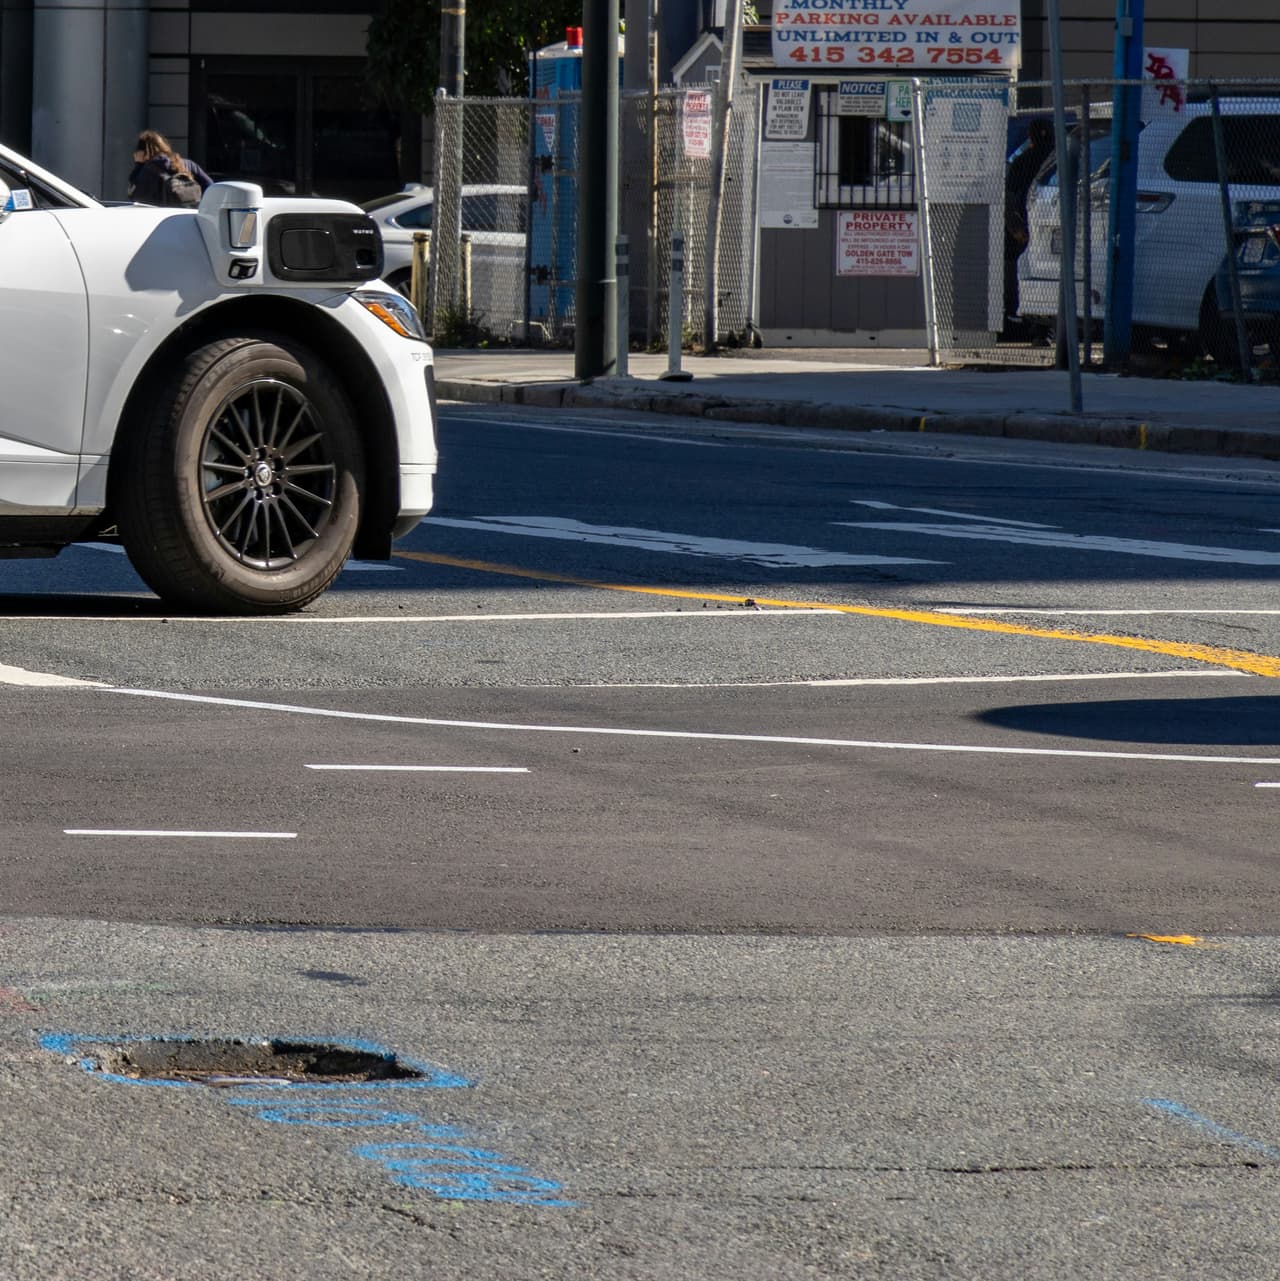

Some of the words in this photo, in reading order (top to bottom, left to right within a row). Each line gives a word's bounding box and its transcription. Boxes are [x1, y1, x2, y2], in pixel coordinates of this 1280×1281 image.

[775, 12, 879, 25] PARKING
[887, 13, 1017, 26] AVAILABLE
[776, 29, 907, 44] UNLIMITED
[915, 31, 939, 44] IN
[948, 31, 963, 44] &
[970, 31, 1019, 44] OUT
[788, 46, 846, 64] 415
[856, 47, 915, 64] 342
[926, 47, 1004, 65] 7554
[778, 80, 803, 89] PLEASE
[841, 83, 884, 94] NOTICE
[899, 85, 911, 95] PA
[853, 212, 907, 222] PRIVATE
[845, 221, 913, 231] PROPERTY
[845, 250, 874, 258] GOLDEN
[876, 250, 896, 258] GATE
[897, 250, 913, 258] TOW
